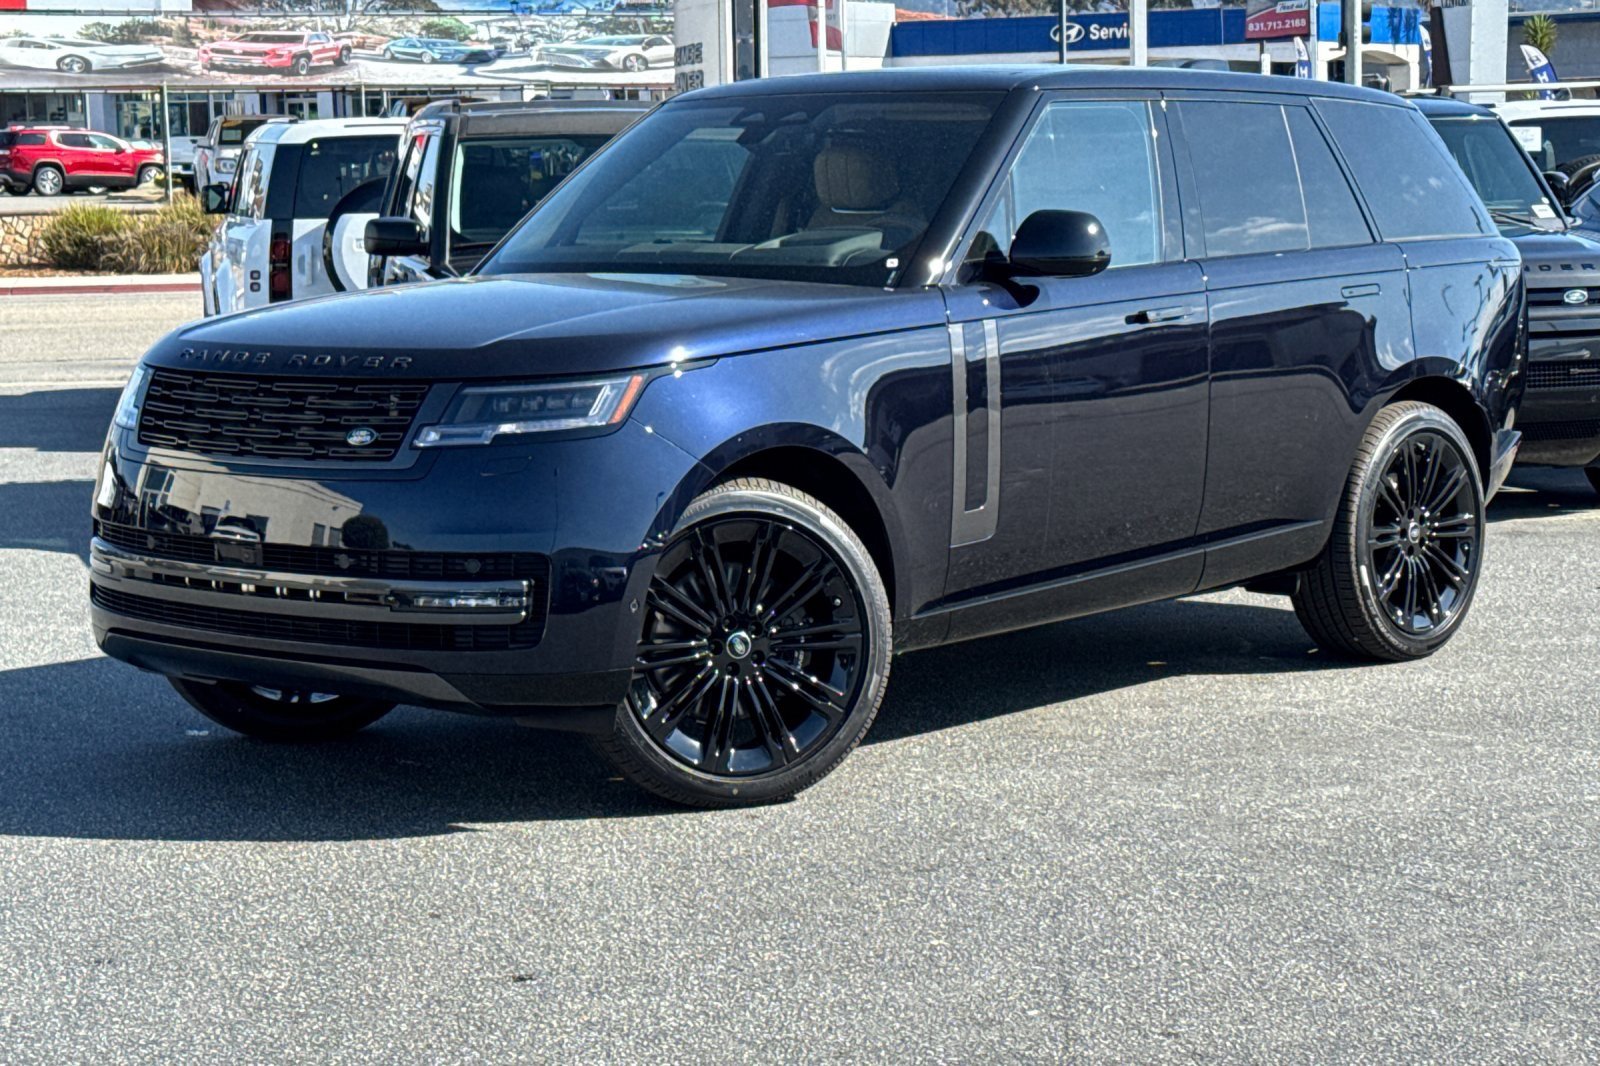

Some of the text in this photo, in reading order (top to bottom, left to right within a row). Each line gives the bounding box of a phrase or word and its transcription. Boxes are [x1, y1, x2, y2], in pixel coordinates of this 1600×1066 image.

[1089, 22, 1132, 40] Servi
[179, 347, 414, 371] RANGE ROVER
